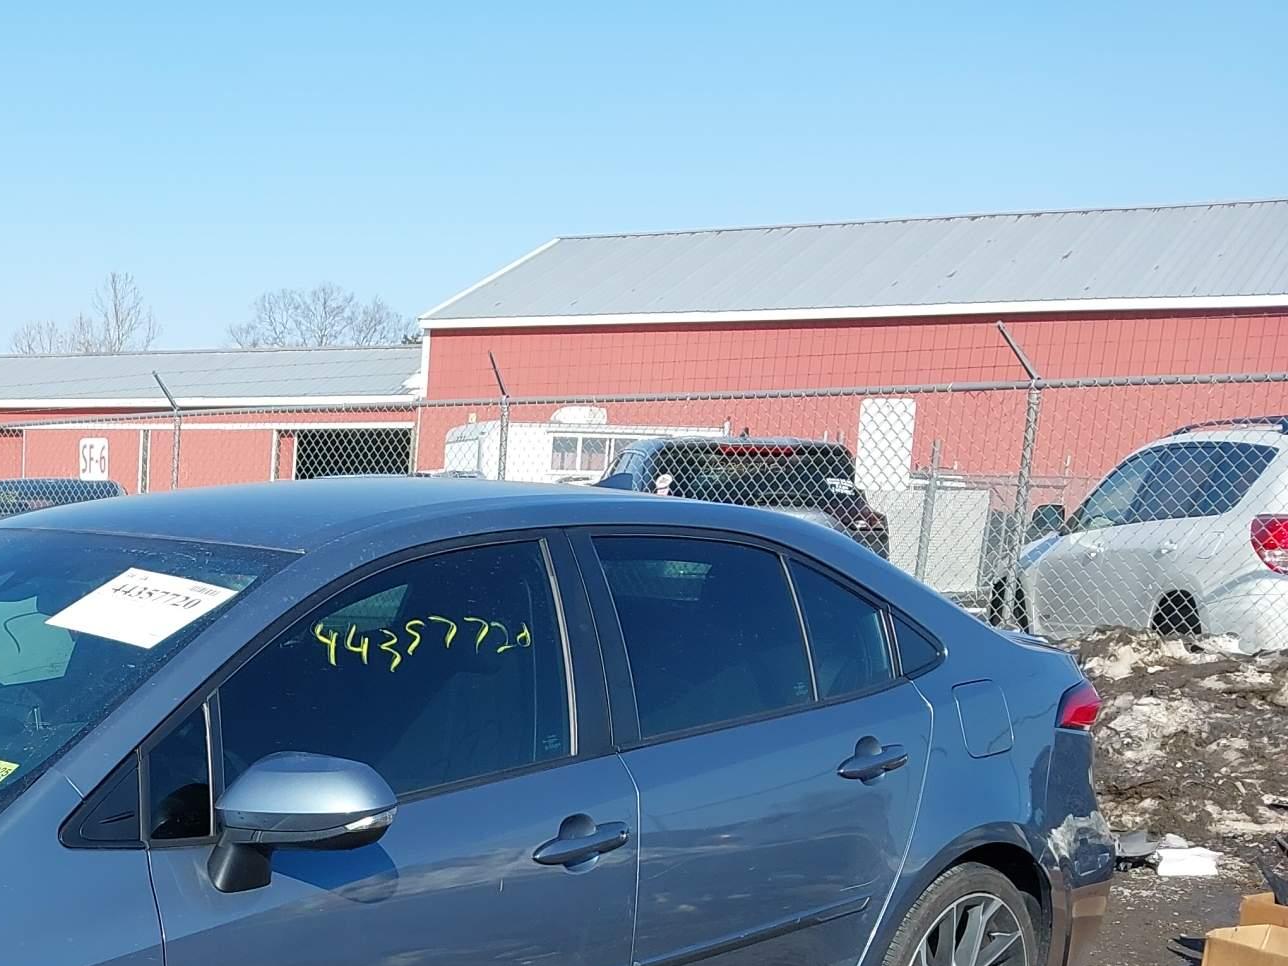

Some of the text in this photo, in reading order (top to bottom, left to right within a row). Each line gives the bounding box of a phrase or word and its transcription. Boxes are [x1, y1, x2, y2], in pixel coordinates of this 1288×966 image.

[81, 444, 106, 474] SF-6
[111, 583, 202, 611] 44357720
[313, 615, 532, 672] 44357720
